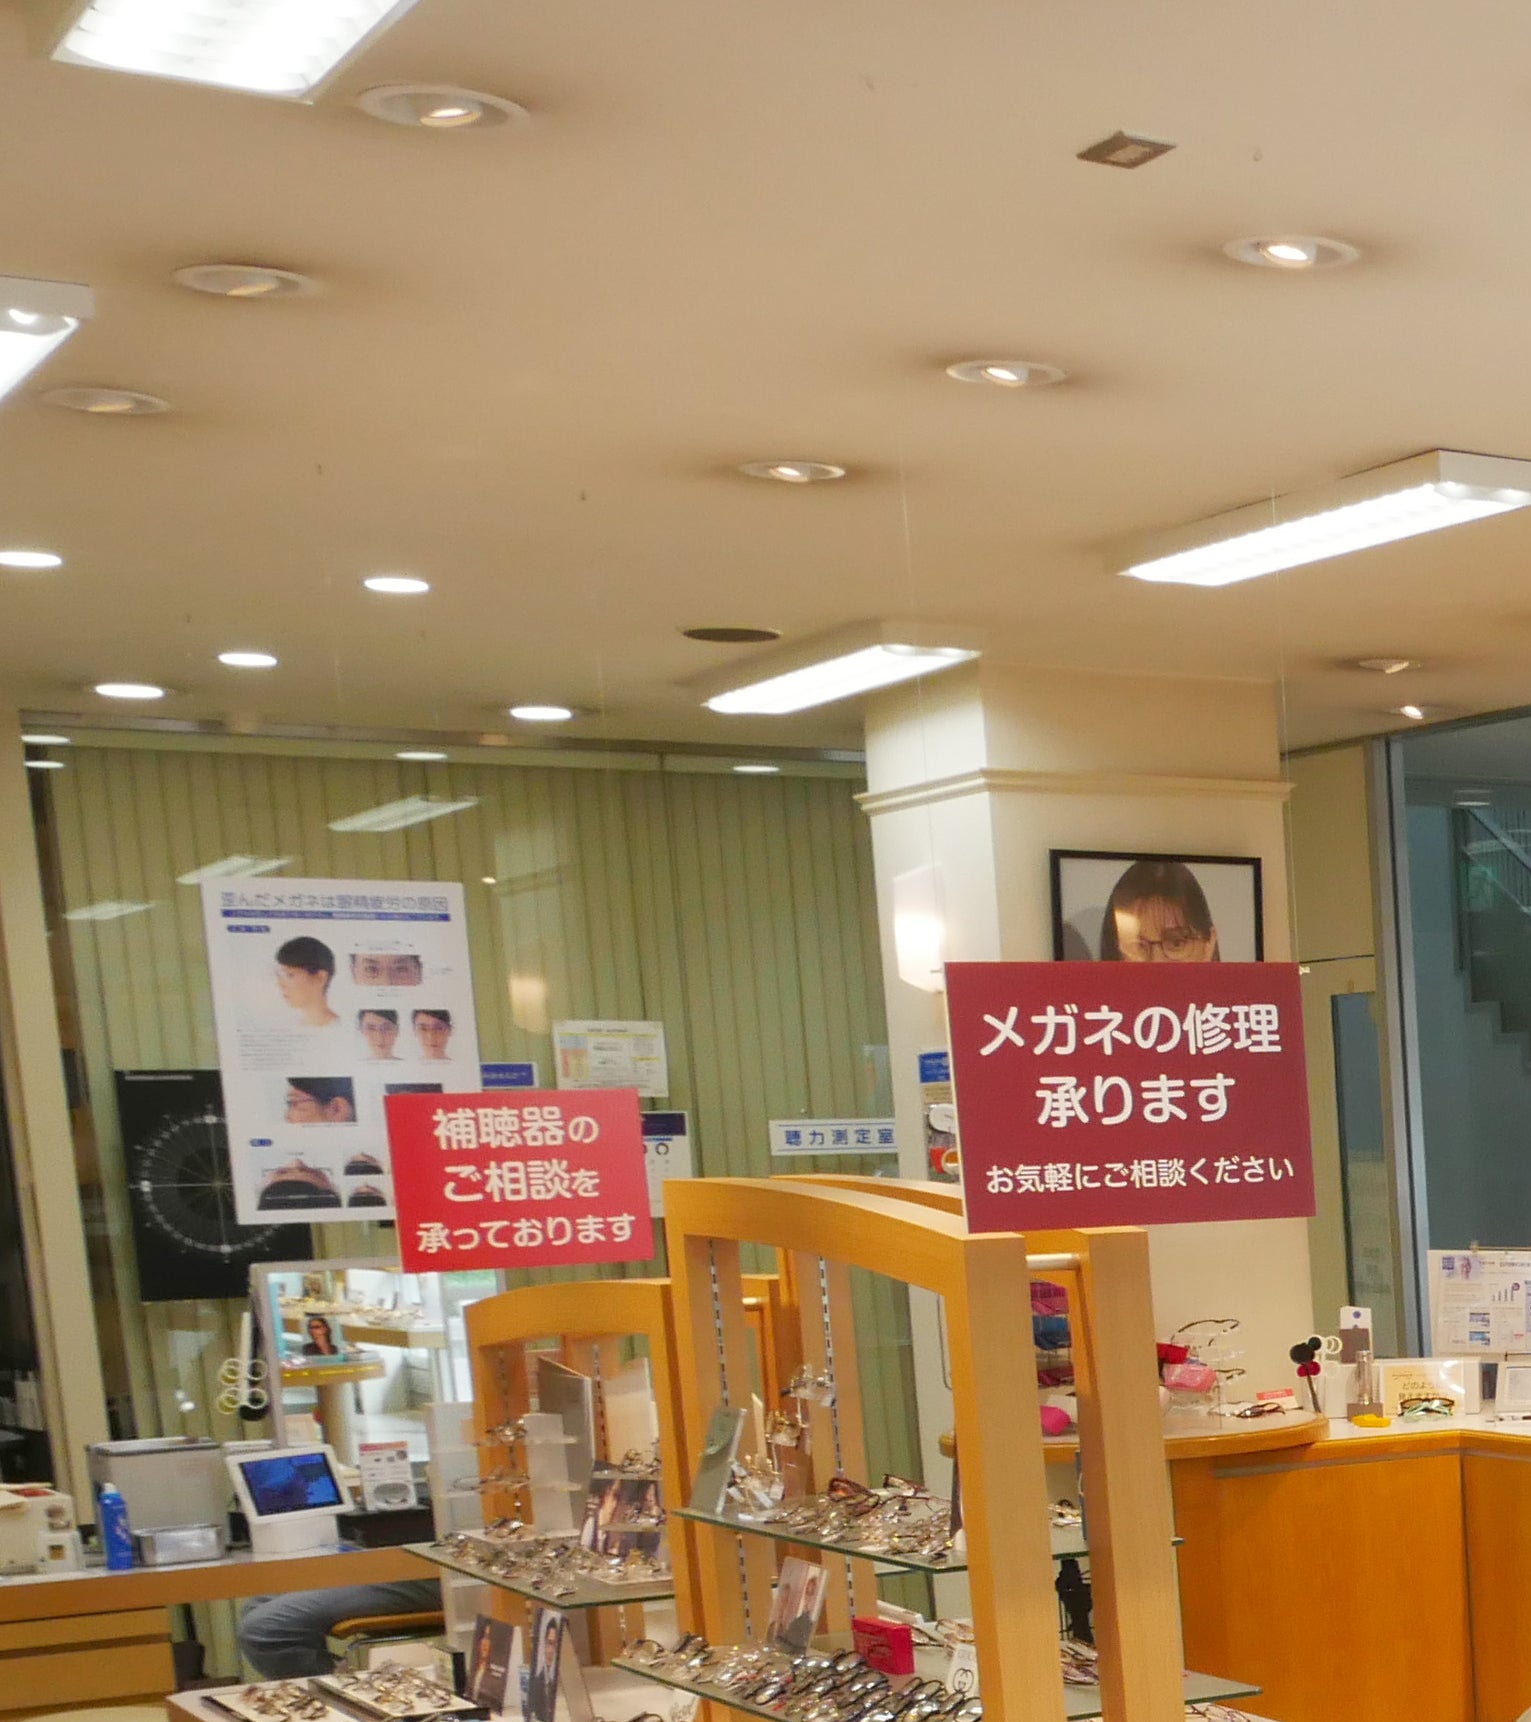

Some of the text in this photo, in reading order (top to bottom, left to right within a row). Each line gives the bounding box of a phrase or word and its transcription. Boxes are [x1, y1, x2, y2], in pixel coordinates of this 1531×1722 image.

[980, 1003, 1283, 1056] メガネの修理
[1035, 1073, 1236, 1128] 承ります
[433, 1106, 599, 1150] 補聴器の
[785, 1128, 896, 1147] 聴力測定室
[444, 1158, 599, 1202] ご相談を
[986, 1156, 1295, 1194] お気軽にご相談ください
[416, 1213, 636, 1254] 承っております
